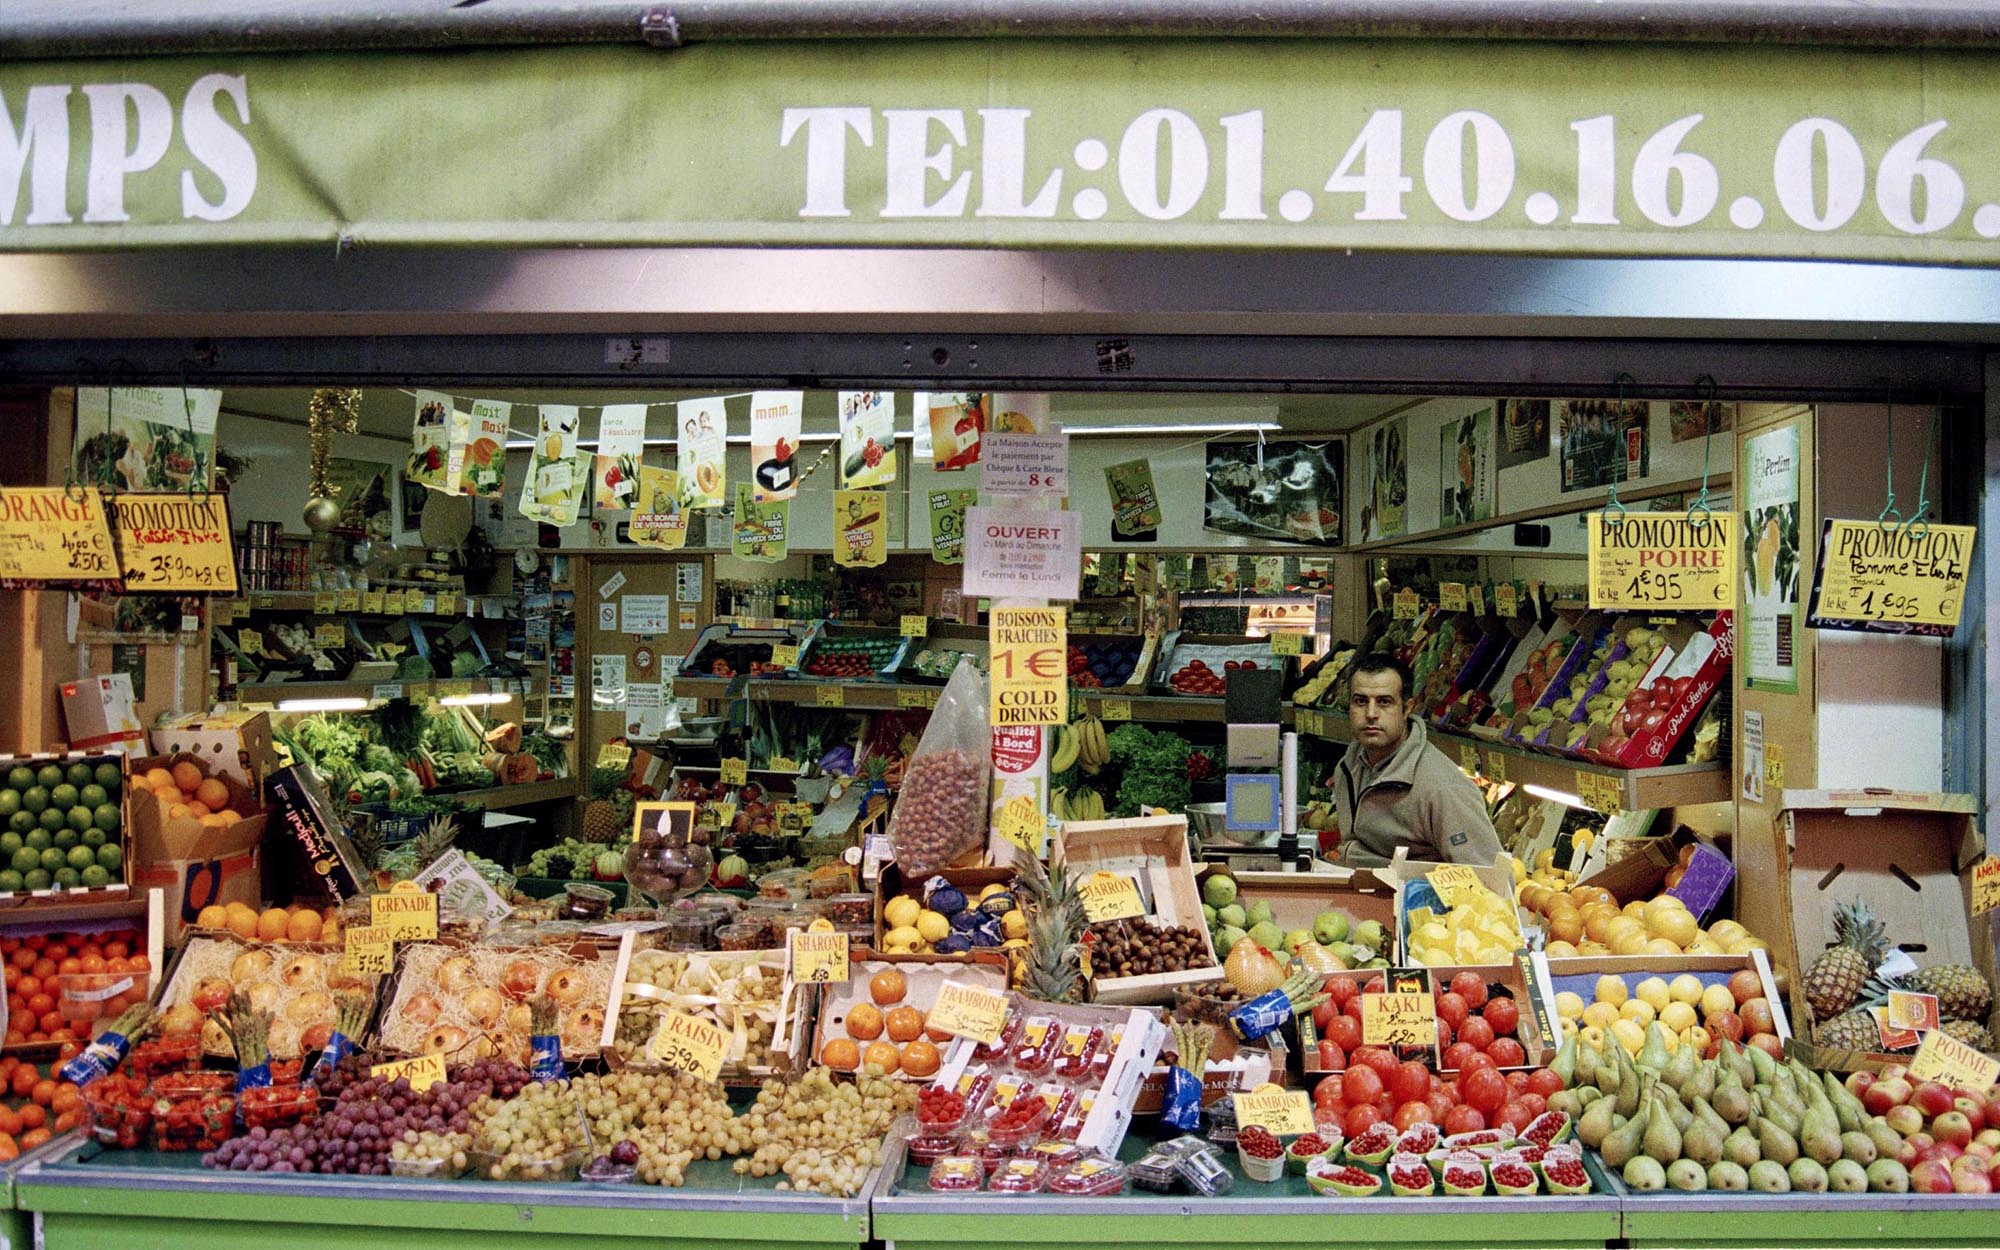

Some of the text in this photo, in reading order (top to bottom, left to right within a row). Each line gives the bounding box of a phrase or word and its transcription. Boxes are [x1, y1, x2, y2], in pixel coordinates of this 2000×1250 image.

[1000, 439, 1029, 447] Maison
[1032, 440, 1063, 449] Accepte
[1000, 452, 1039, 461] paiement
[1041, 454, 1054, 462] par
[1016, 464, 1021, 472] &
[1022, 464, 1042, 473] Carte
[1028, 473, 1039, 487] 8
[1044, 476, 1055, 487] €
[931, 493, 948, 503] MINI
[111, 502, 219, 531] PROMOTION
[638, 513, 681, 522] UNE BOMBE
[763, 519, 783, 528] FIBRE
[772, 513, 782, 521] LA
[634, 521, 645, 529] DE
[646, 521, 678, 529] VITAMINE
[773, 526, 784, 535] DU
[987, 526, 1062, 540] OUVERT
[739, 533, 785, 544] SAMEDI SOIR
[1600, 519, 1727, 548] PROMOTION
[1839, 528, 1965, 562] PROMOTION
[1639, 550, 1725, 568] POIRE
[1850, 555, 1908, 576] Pomme
[1032, 572, 1061, 581] Lundi
[1608, 588, 1619, 601] kg
[1713, 583, 1728, 601] €
[1836, 597, 1848, 612] kg
[1939, 598, 1954, 617] €
[998, 612, 1056, 627] BOISSONS
[998, 628, 1058, 643] FRAICHES
[993, 649, 1063, 680] 1 €
[999, 690, 1057, 706] COLD
[999, 707, 1058, 723] DRINKS
[1665, 703, 1689, 742] Pink
[1003, 737, 1033, 749] Bord
[1010, 800, 1042, 828] CITRON
[448, 861, 468, 879] sur
[377, 896, 432, 913] GRENADE
[350, 928, 391, 946] ASPERGES
[798, 935, 845, 952] SHARONE
[943, 985, 1003, 1014] FRAMBOISE
[1379, 996, 1421, 1013] KAKI
[671, 1016, 724, 1050] RAISIN
[1935, 1035, 1990, 1075] POMME
[378, 1057, 439, 1079] RAISIN
[1242, 1095, 1301, 1111] FRAMBOISE
